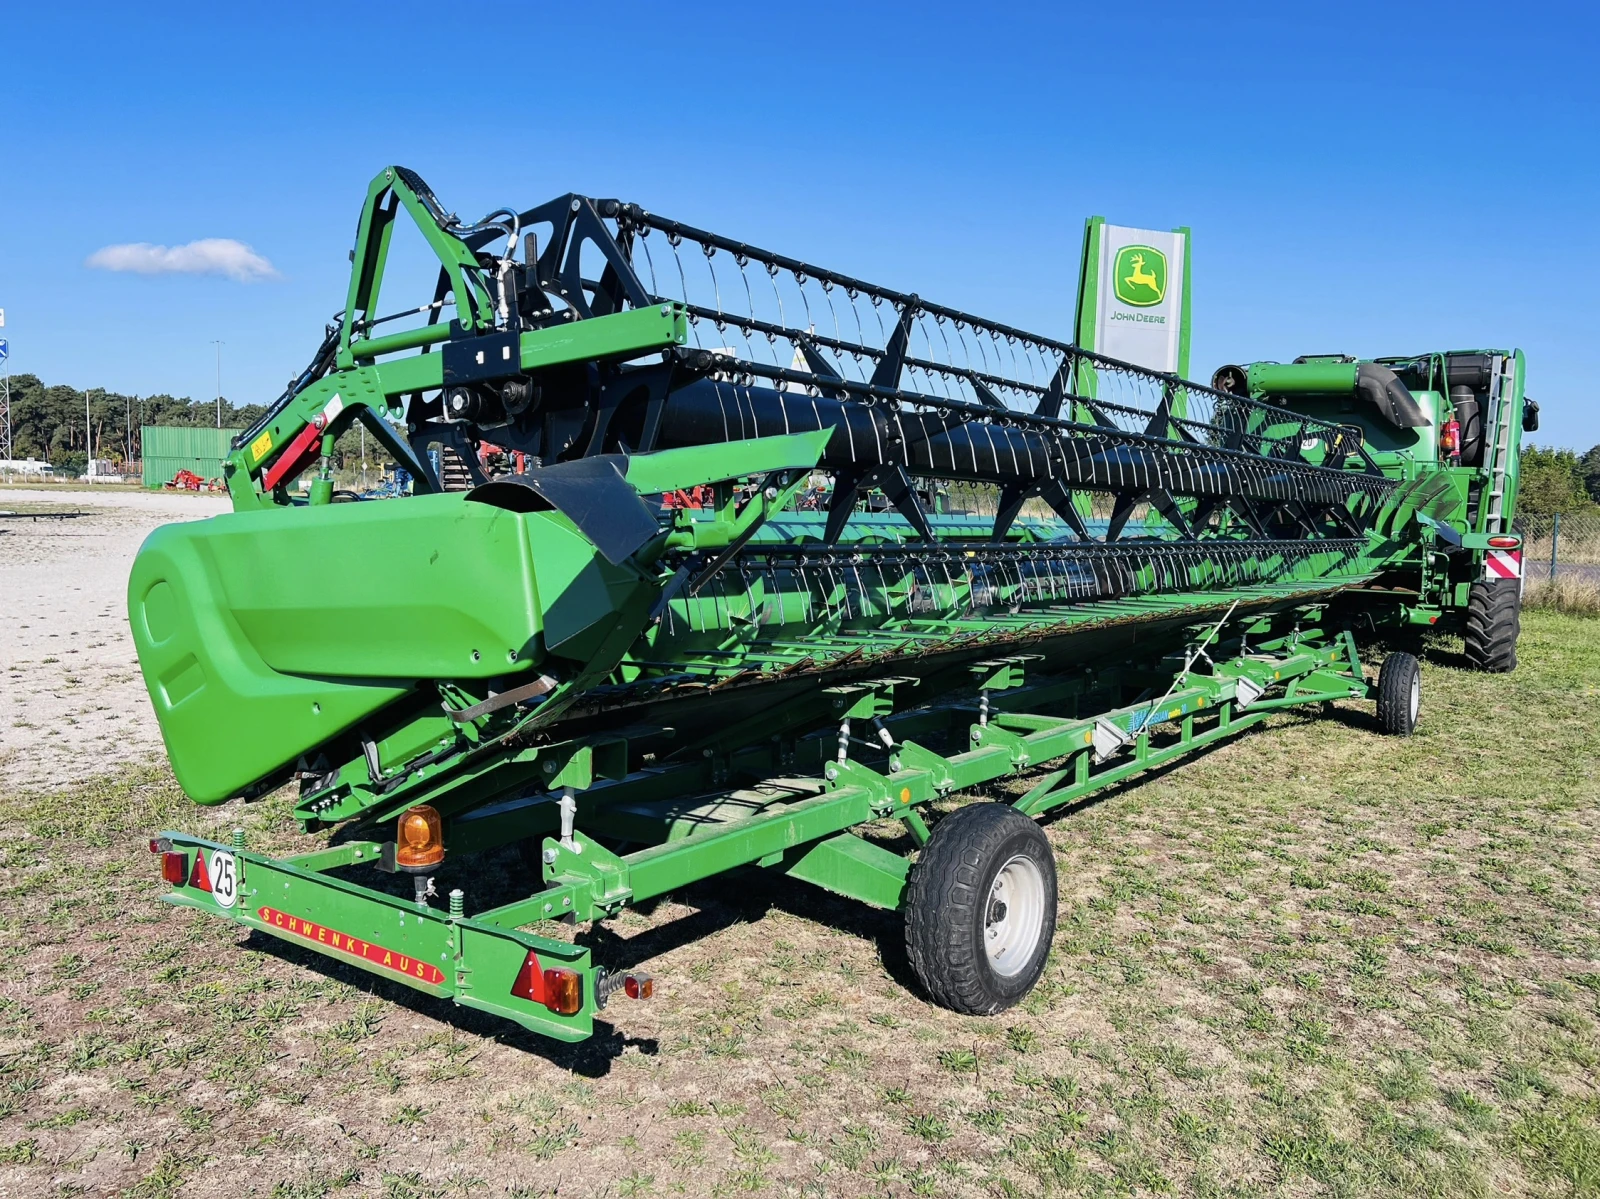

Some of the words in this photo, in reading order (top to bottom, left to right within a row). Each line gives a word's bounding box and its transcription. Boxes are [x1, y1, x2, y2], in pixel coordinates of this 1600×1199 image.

[1110, 311, 1135, 321] JOHN
[1136, 313, 1165, 323] DEERE
[215, 856, 233, 897] 25
[263, 908, 370, 956] SCHWENKT
[383, 951, 438, 983] AUS!
